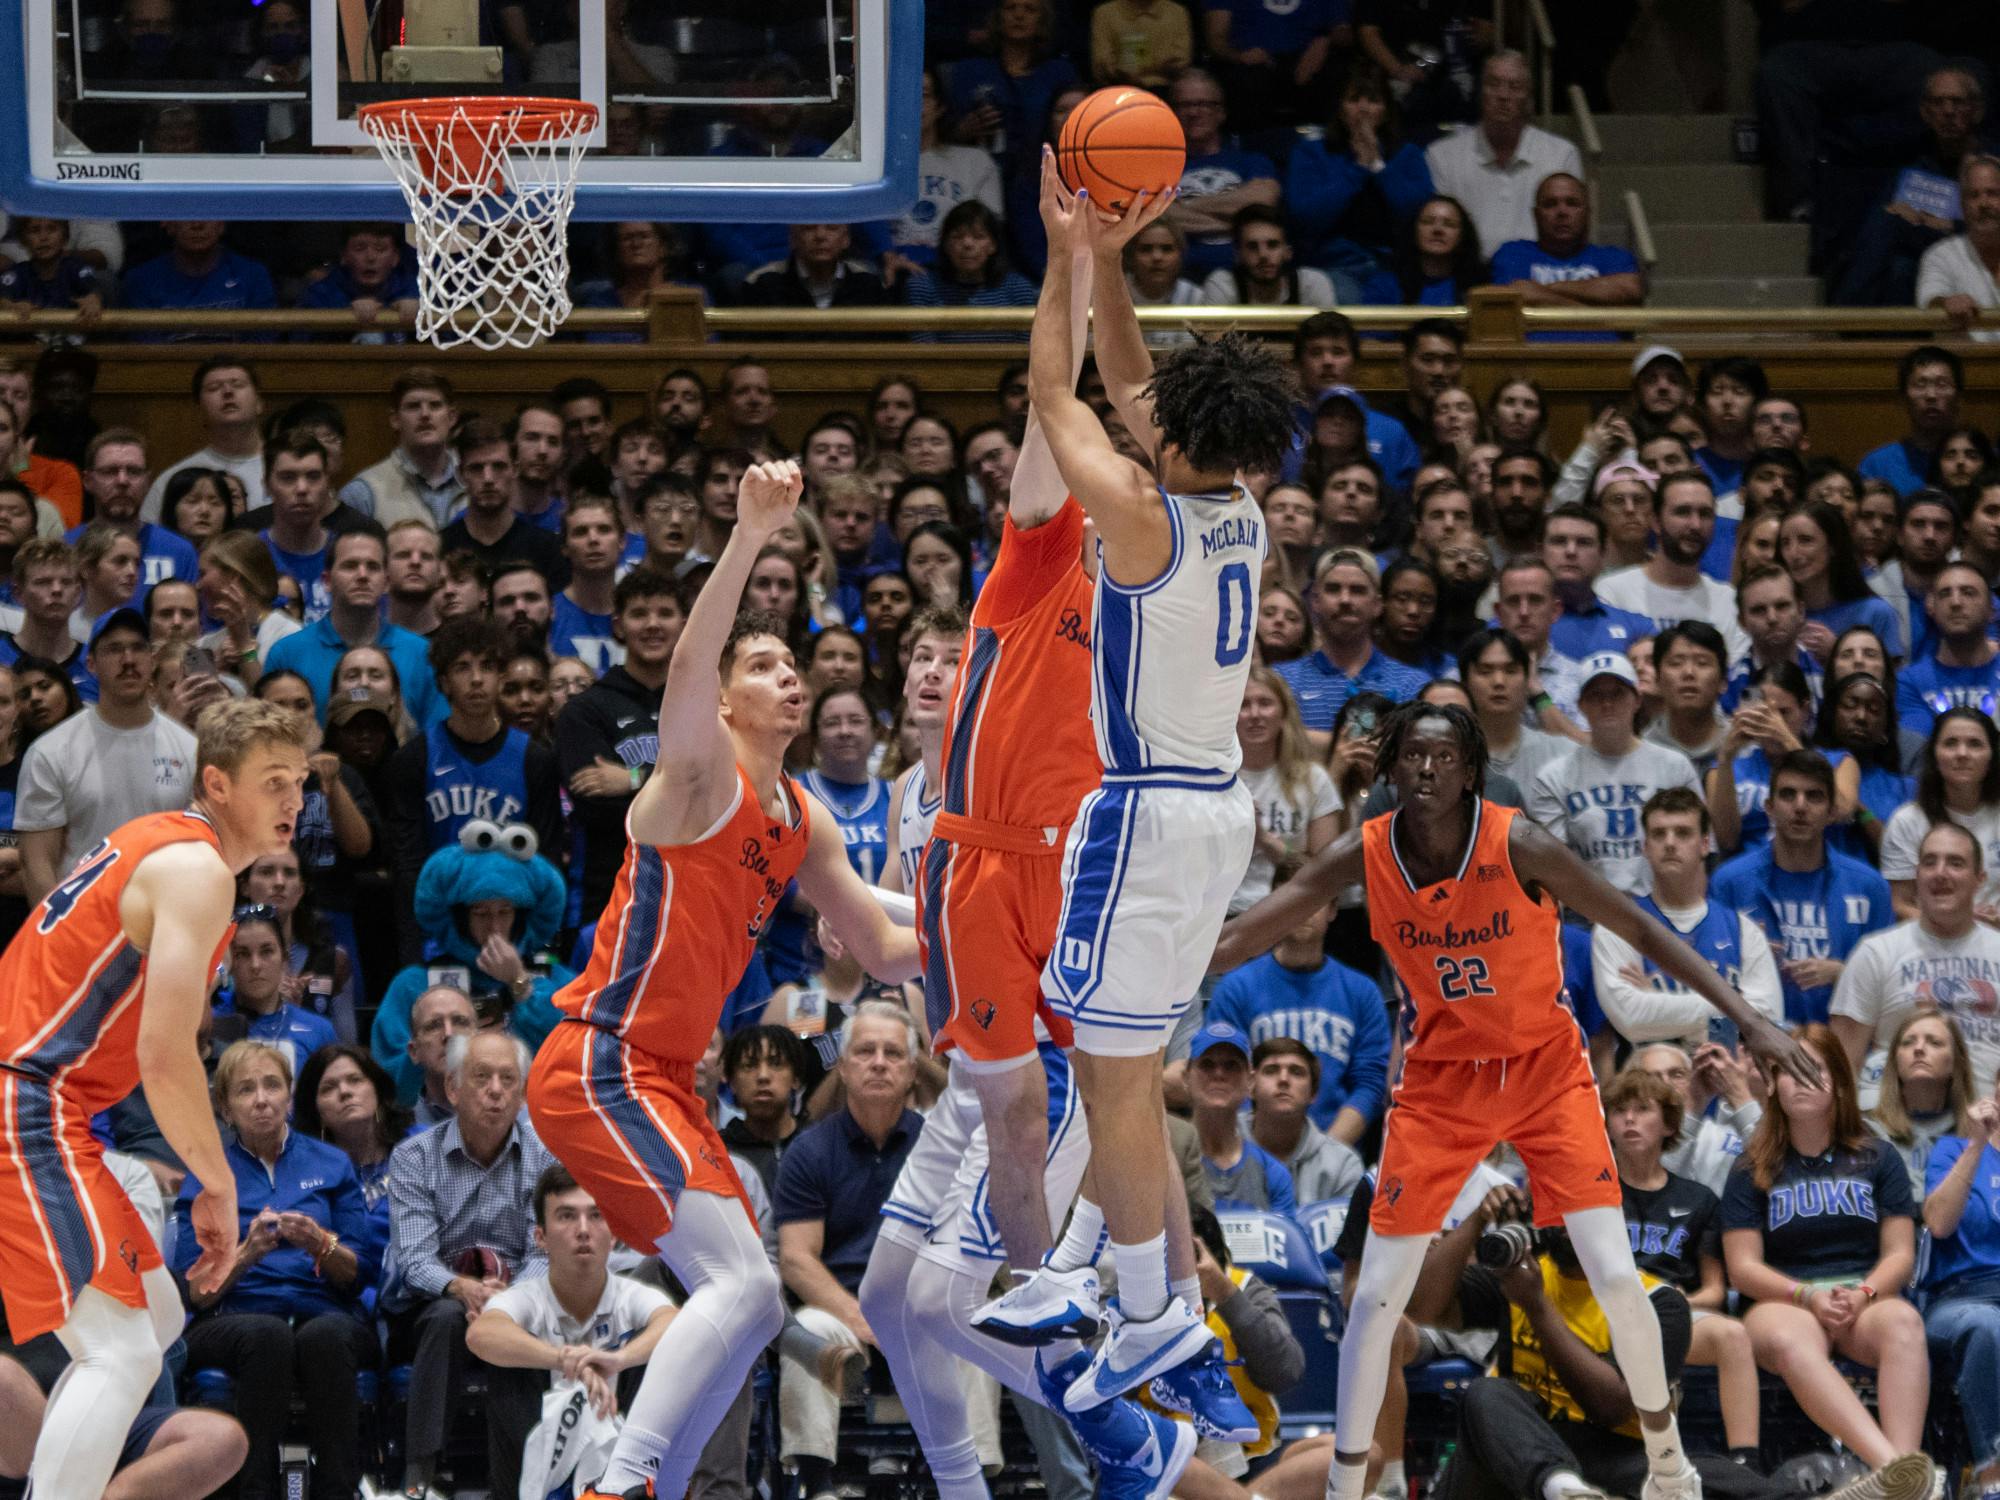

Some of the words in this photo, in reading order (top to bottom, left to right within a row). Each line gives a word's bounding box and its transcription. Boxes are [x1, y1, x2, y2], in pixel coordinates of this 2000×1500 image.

[57, 162, 143, 181] SPALDING
[1214, 561, 1252, 668] 0
[1566, 784, 1649, 818] DUK
[838, 823, 889, 846] UK
[1392, 909, 1515, 949] Bucknell
[1062, 936, 1091, 971] D
[1434, 955, 1497, 1002] 22
[1250, 1010, 1356, 1067] DUKE
[1769, 1179, 1878, 1232] DUKE
